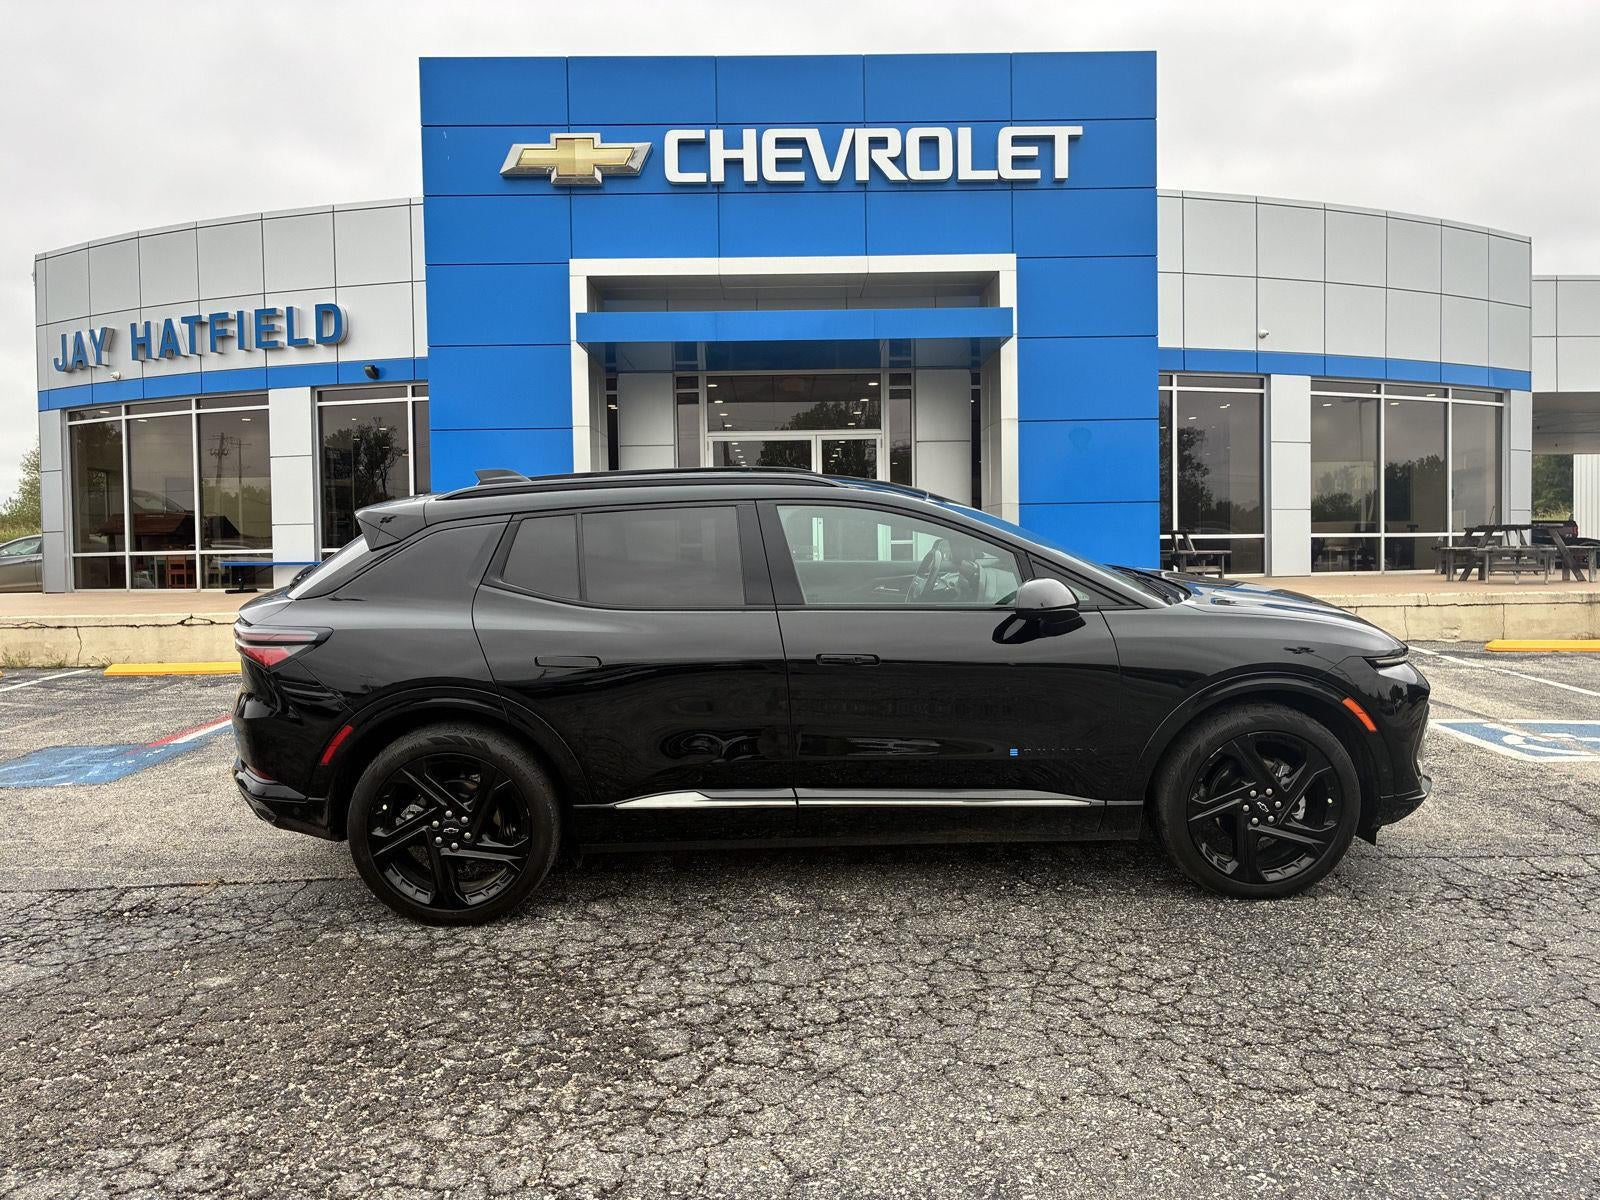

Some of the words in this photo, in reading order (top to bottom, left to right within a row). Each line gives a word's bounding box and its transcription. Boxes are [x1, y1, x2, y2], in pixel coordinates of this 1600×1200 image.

[664, 125, 1083, 184] CHEVROLET
[53, 327, 114, 373] JAY
[130, 303, 346, 362] HATFIELD
